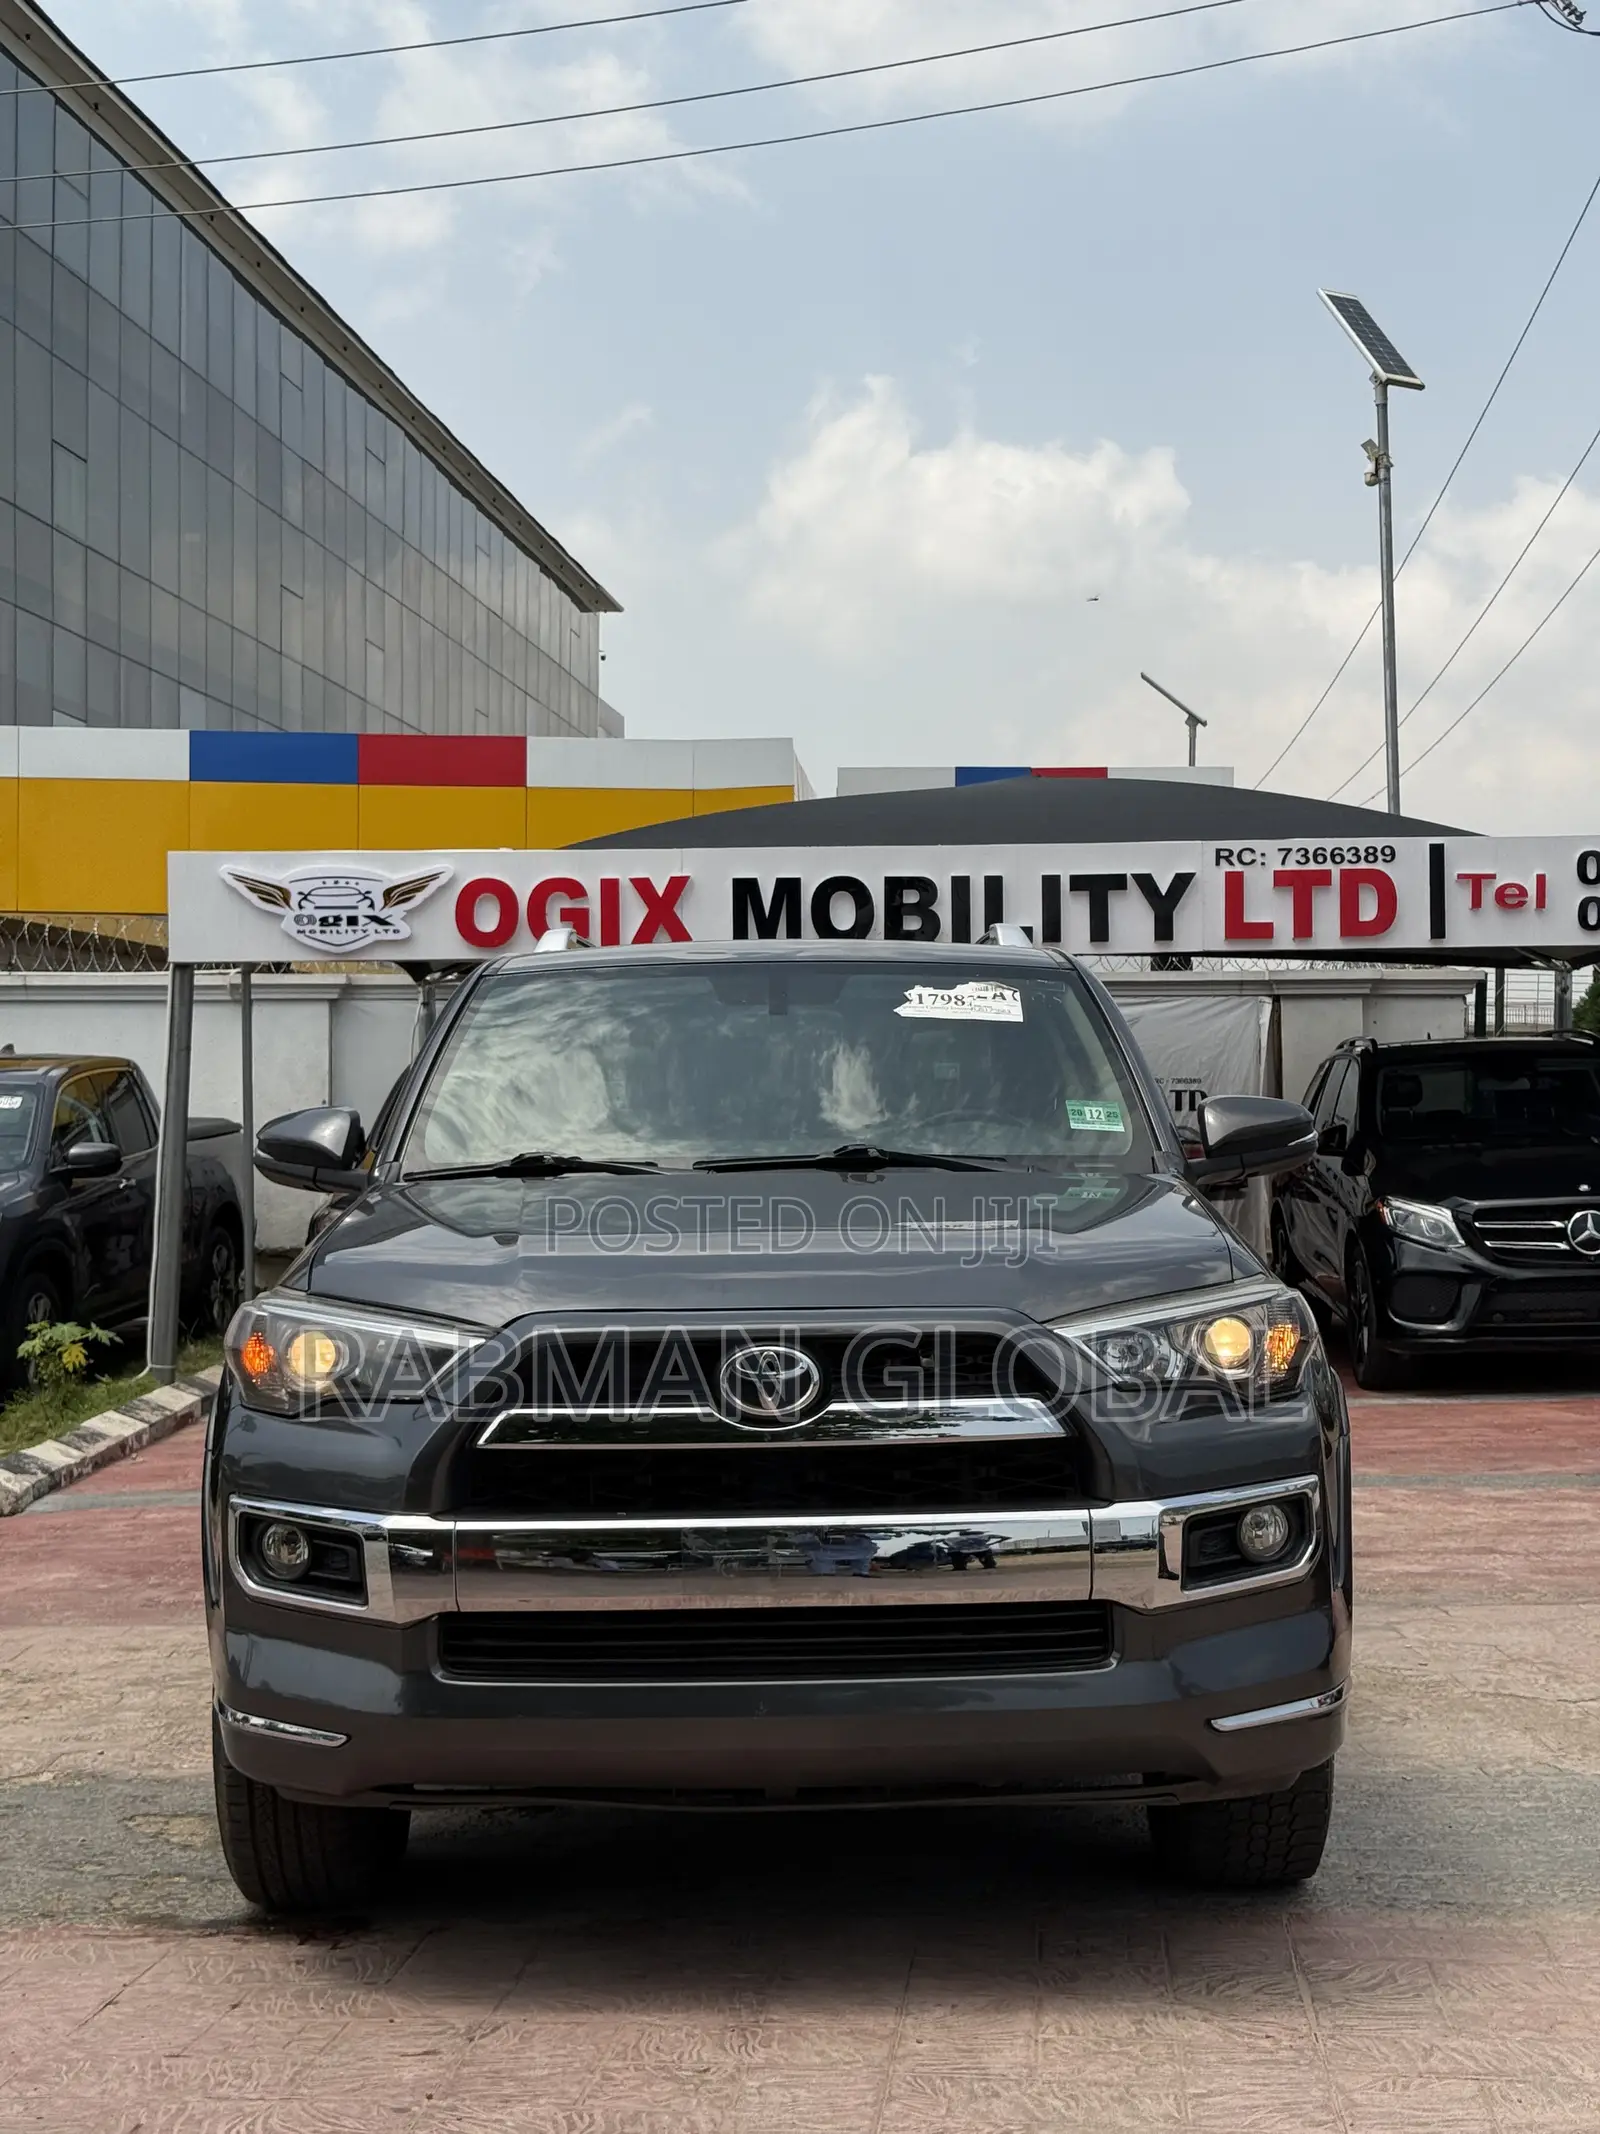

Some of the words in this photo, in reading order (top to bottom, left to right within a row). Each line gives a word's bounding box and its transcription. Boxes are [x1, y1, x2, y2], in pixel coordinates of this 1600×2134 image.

[1214, 847, 1267, 866] RC:
[1277, 845, 1396, 865] 7366389
[1456, 873, 1546, 910] Tel
[455, 875, 693, 948] OGIX
[732, 872, 1196, 943] MOBILITY
[1224, 868, 1398, 940] LTD
[1070, 1108, 1083, 1117] 20
[1088, 1108, 1103, 1120] 12
